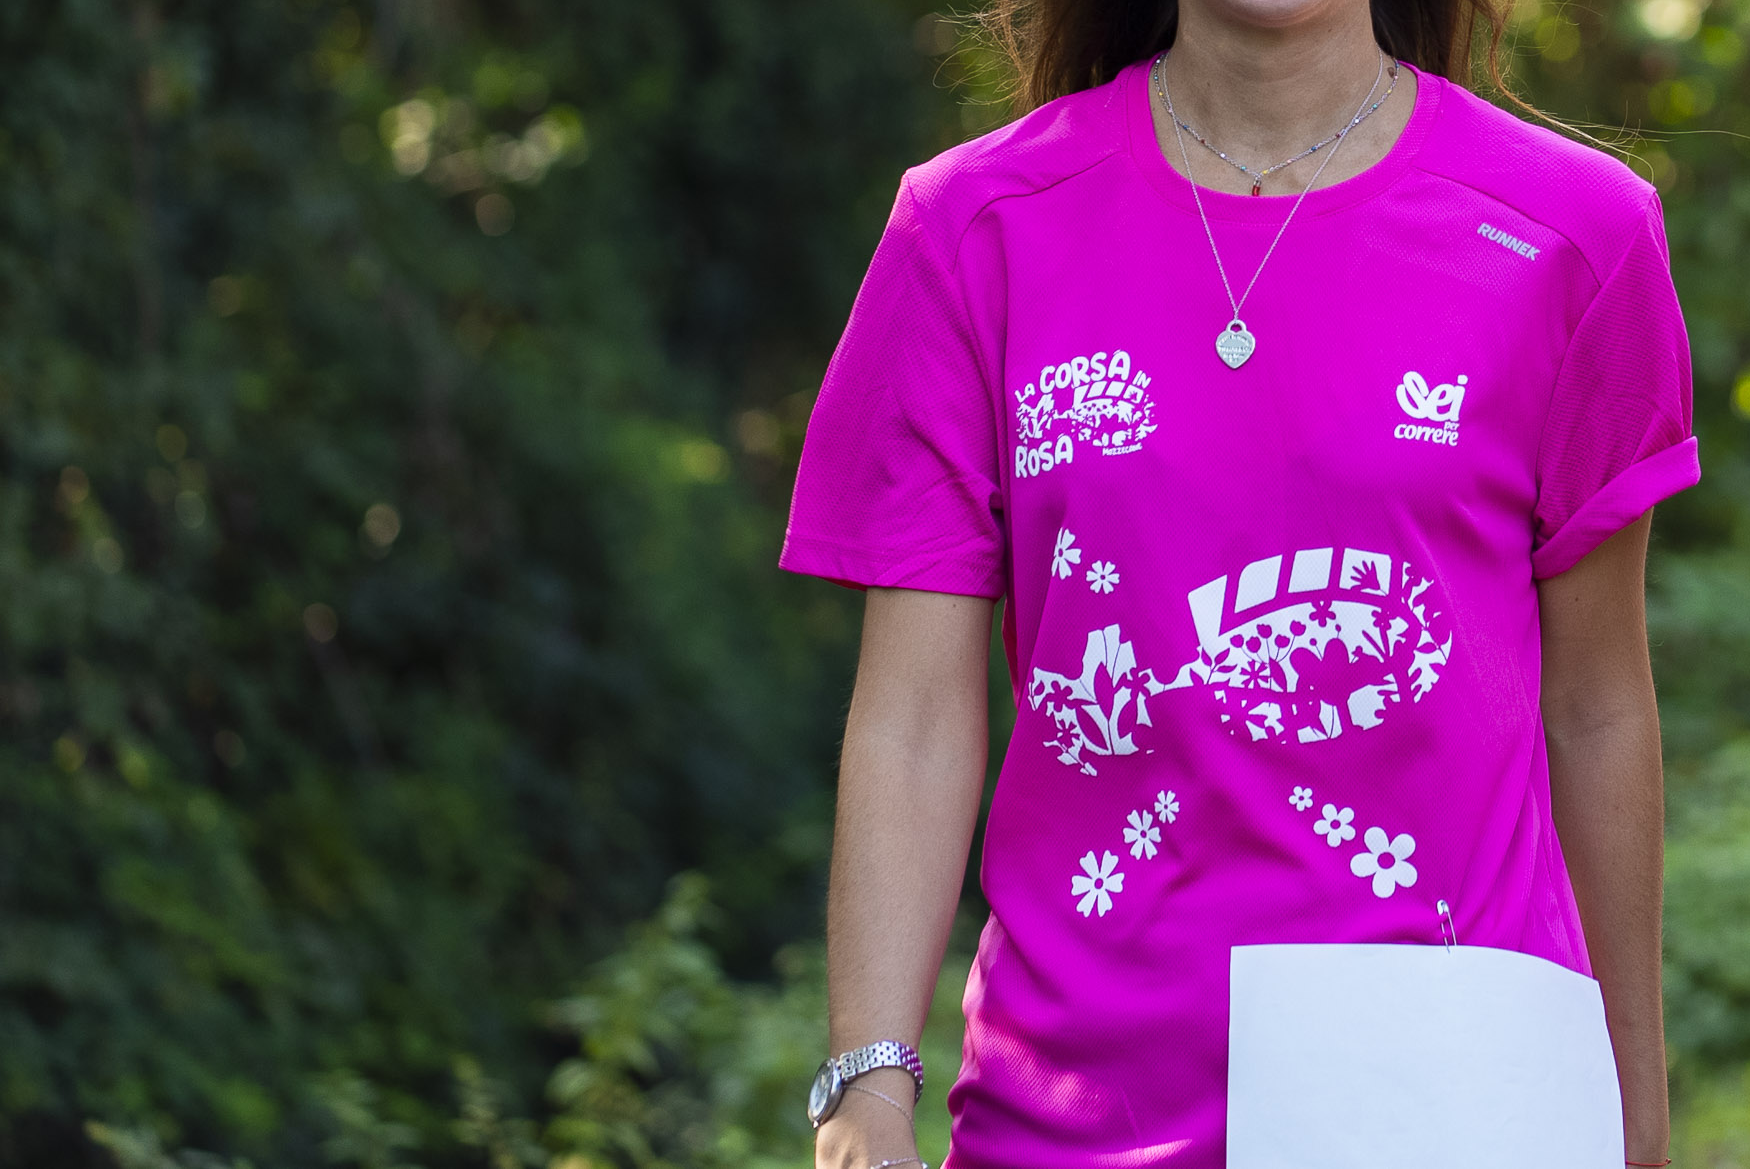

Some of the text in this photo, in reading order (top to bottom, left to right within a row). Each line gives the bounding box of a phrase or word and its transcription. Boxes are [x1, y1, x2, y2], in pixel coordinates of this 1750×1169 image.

[1476, 222, 1541, 262] RUNNEK
[1014, 383, 1036, 404] LA
[1039, 349, 1131, 394] CORSA
[1394, 423, 1459, 446] correre
[1015, 434, 1074, 478] ROSA
